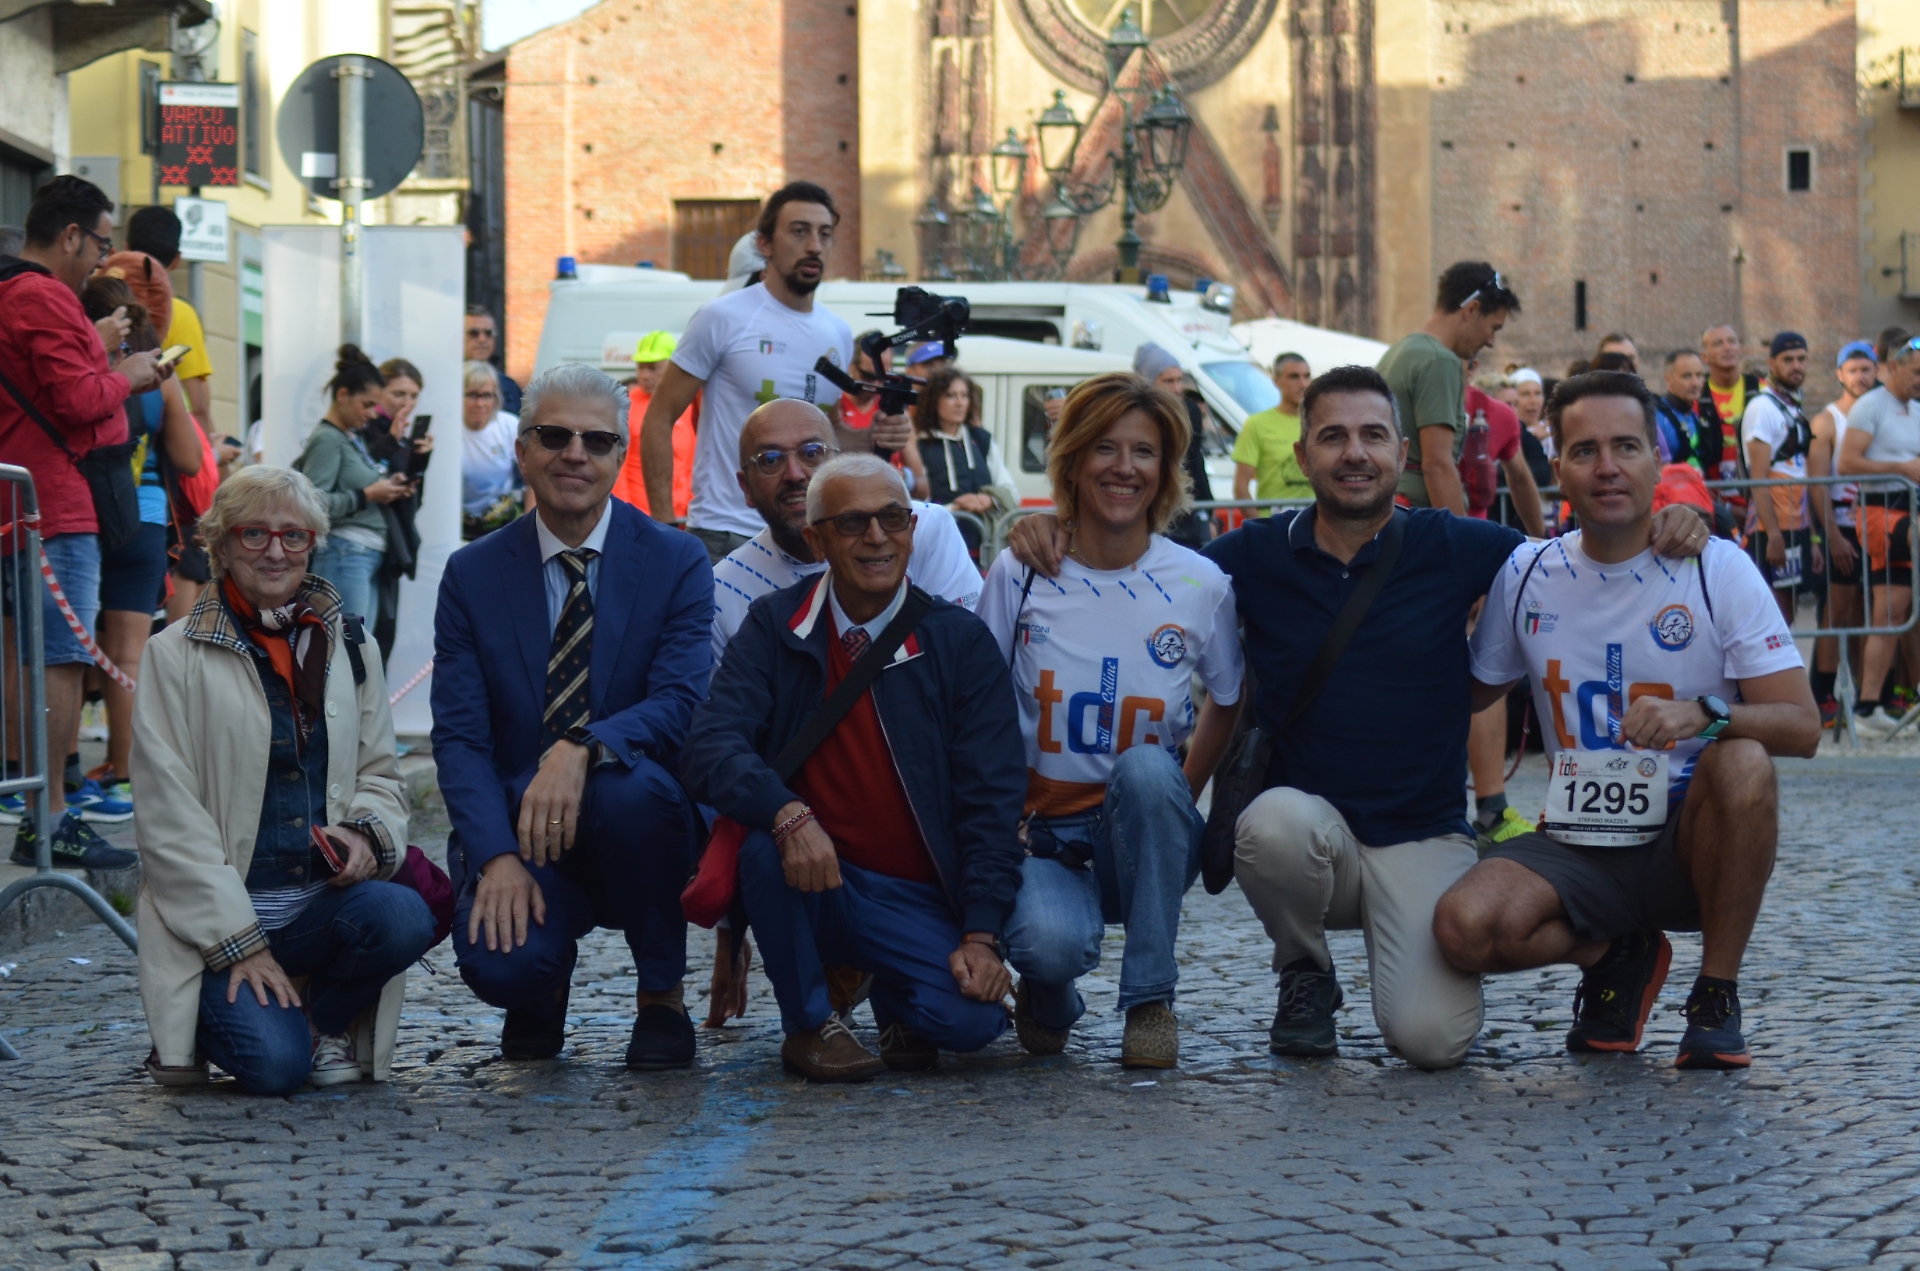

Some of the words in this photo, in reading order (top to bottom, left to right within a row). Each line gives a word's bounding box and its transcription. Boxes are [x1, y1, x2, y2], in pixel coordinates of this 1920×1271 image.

[162, 125, 236, 146] ATTIVO
[891, 329, 918, 345] RONIN
[1540, 612, 1559, 622] CONI
[1030, 624, 1050, 634] CONI
[1607, 647, 1621, 692] Colline
[1101, 660, 1117, 704] Colline
[1097, 726, 1110, 754] Trail
[1558, 757, 1578, 776] tdc
[1564, 780, 1650, 815] 1295
